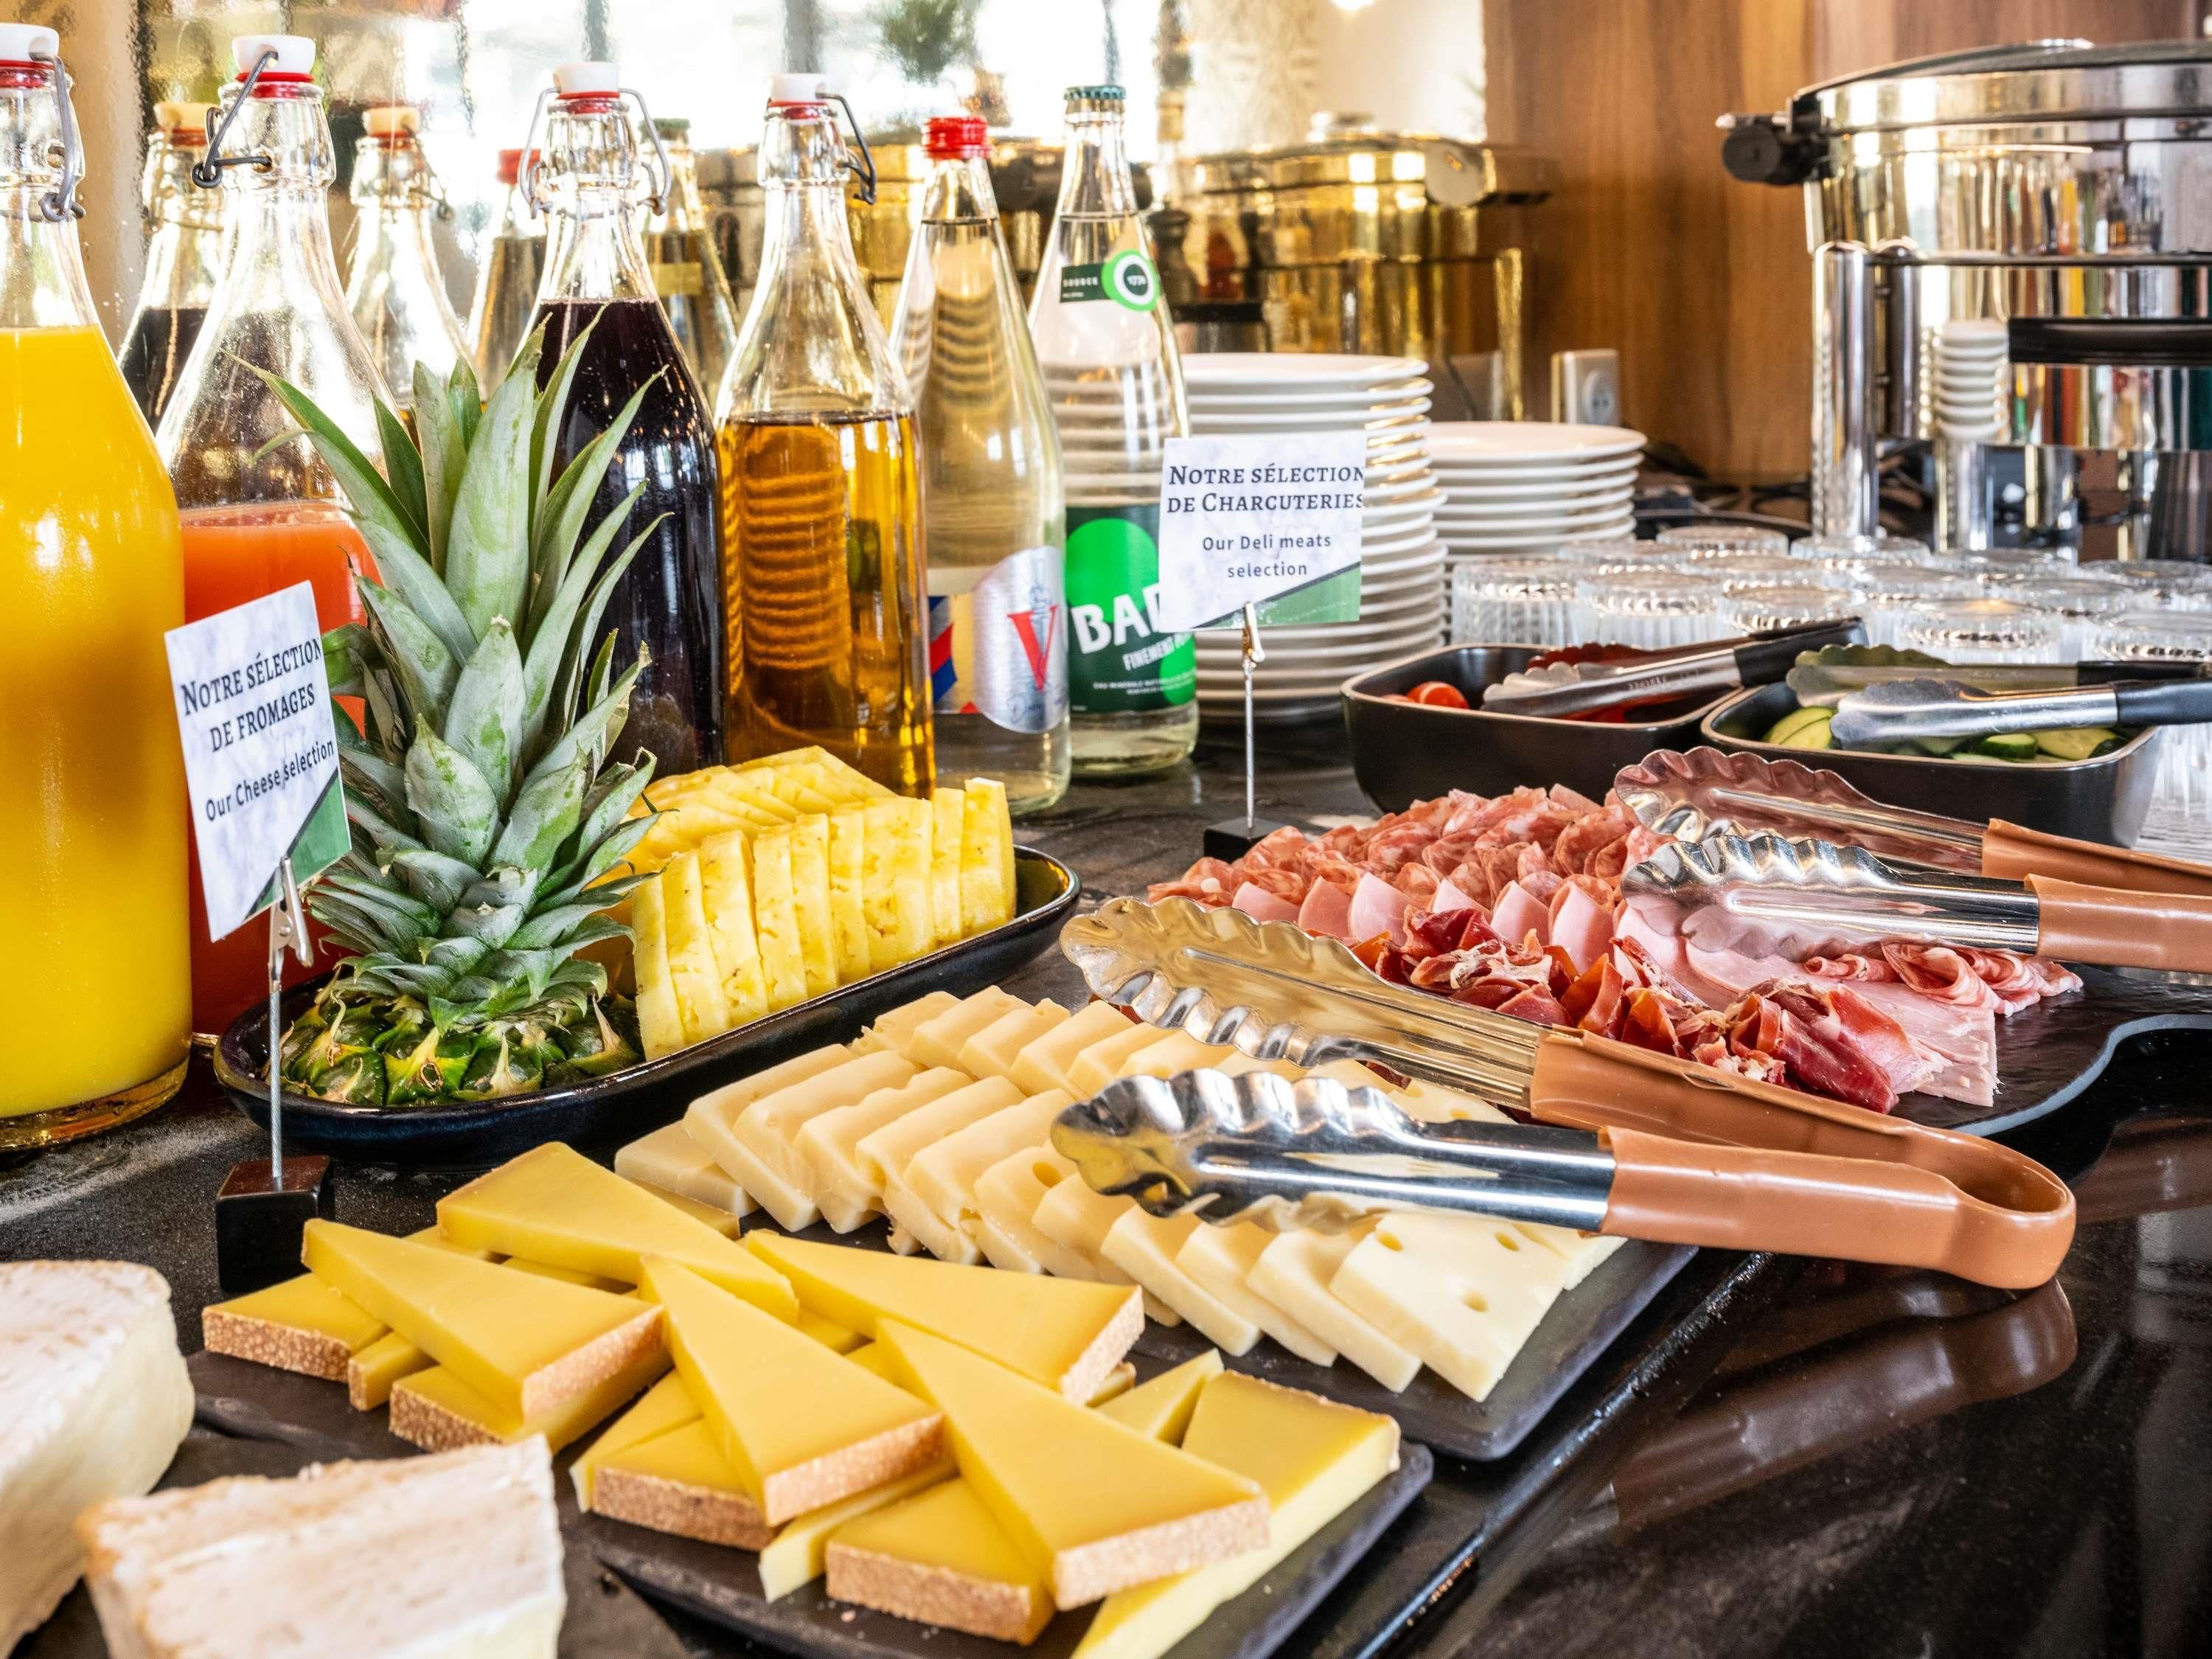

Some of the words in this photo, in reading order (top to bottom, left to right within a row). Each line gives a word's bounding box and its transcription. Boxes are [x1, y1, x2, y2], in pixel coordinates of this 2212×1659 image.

[1169, 465, 1245, 485] NOTRE
[1166, 496, 1195, 513] DE
[1201, 492, 1363, 512] CHARCUTERIES
[1203, 537, 1234, 551] Our
[1240, 534, 1273, 550] Deli
[1279, 534, 1331, 549] meats
[1228, 561, 1307, 578] selection
[181, 669, 243, 716] NOTRE
[209, 720, 234, 753] DE
[236, 683, 316, 740] FROMAGES
[206, 794, 232, 821] Our
[235, 769, 280, 807] Cheese
[283, 740, 335, 782] selection
